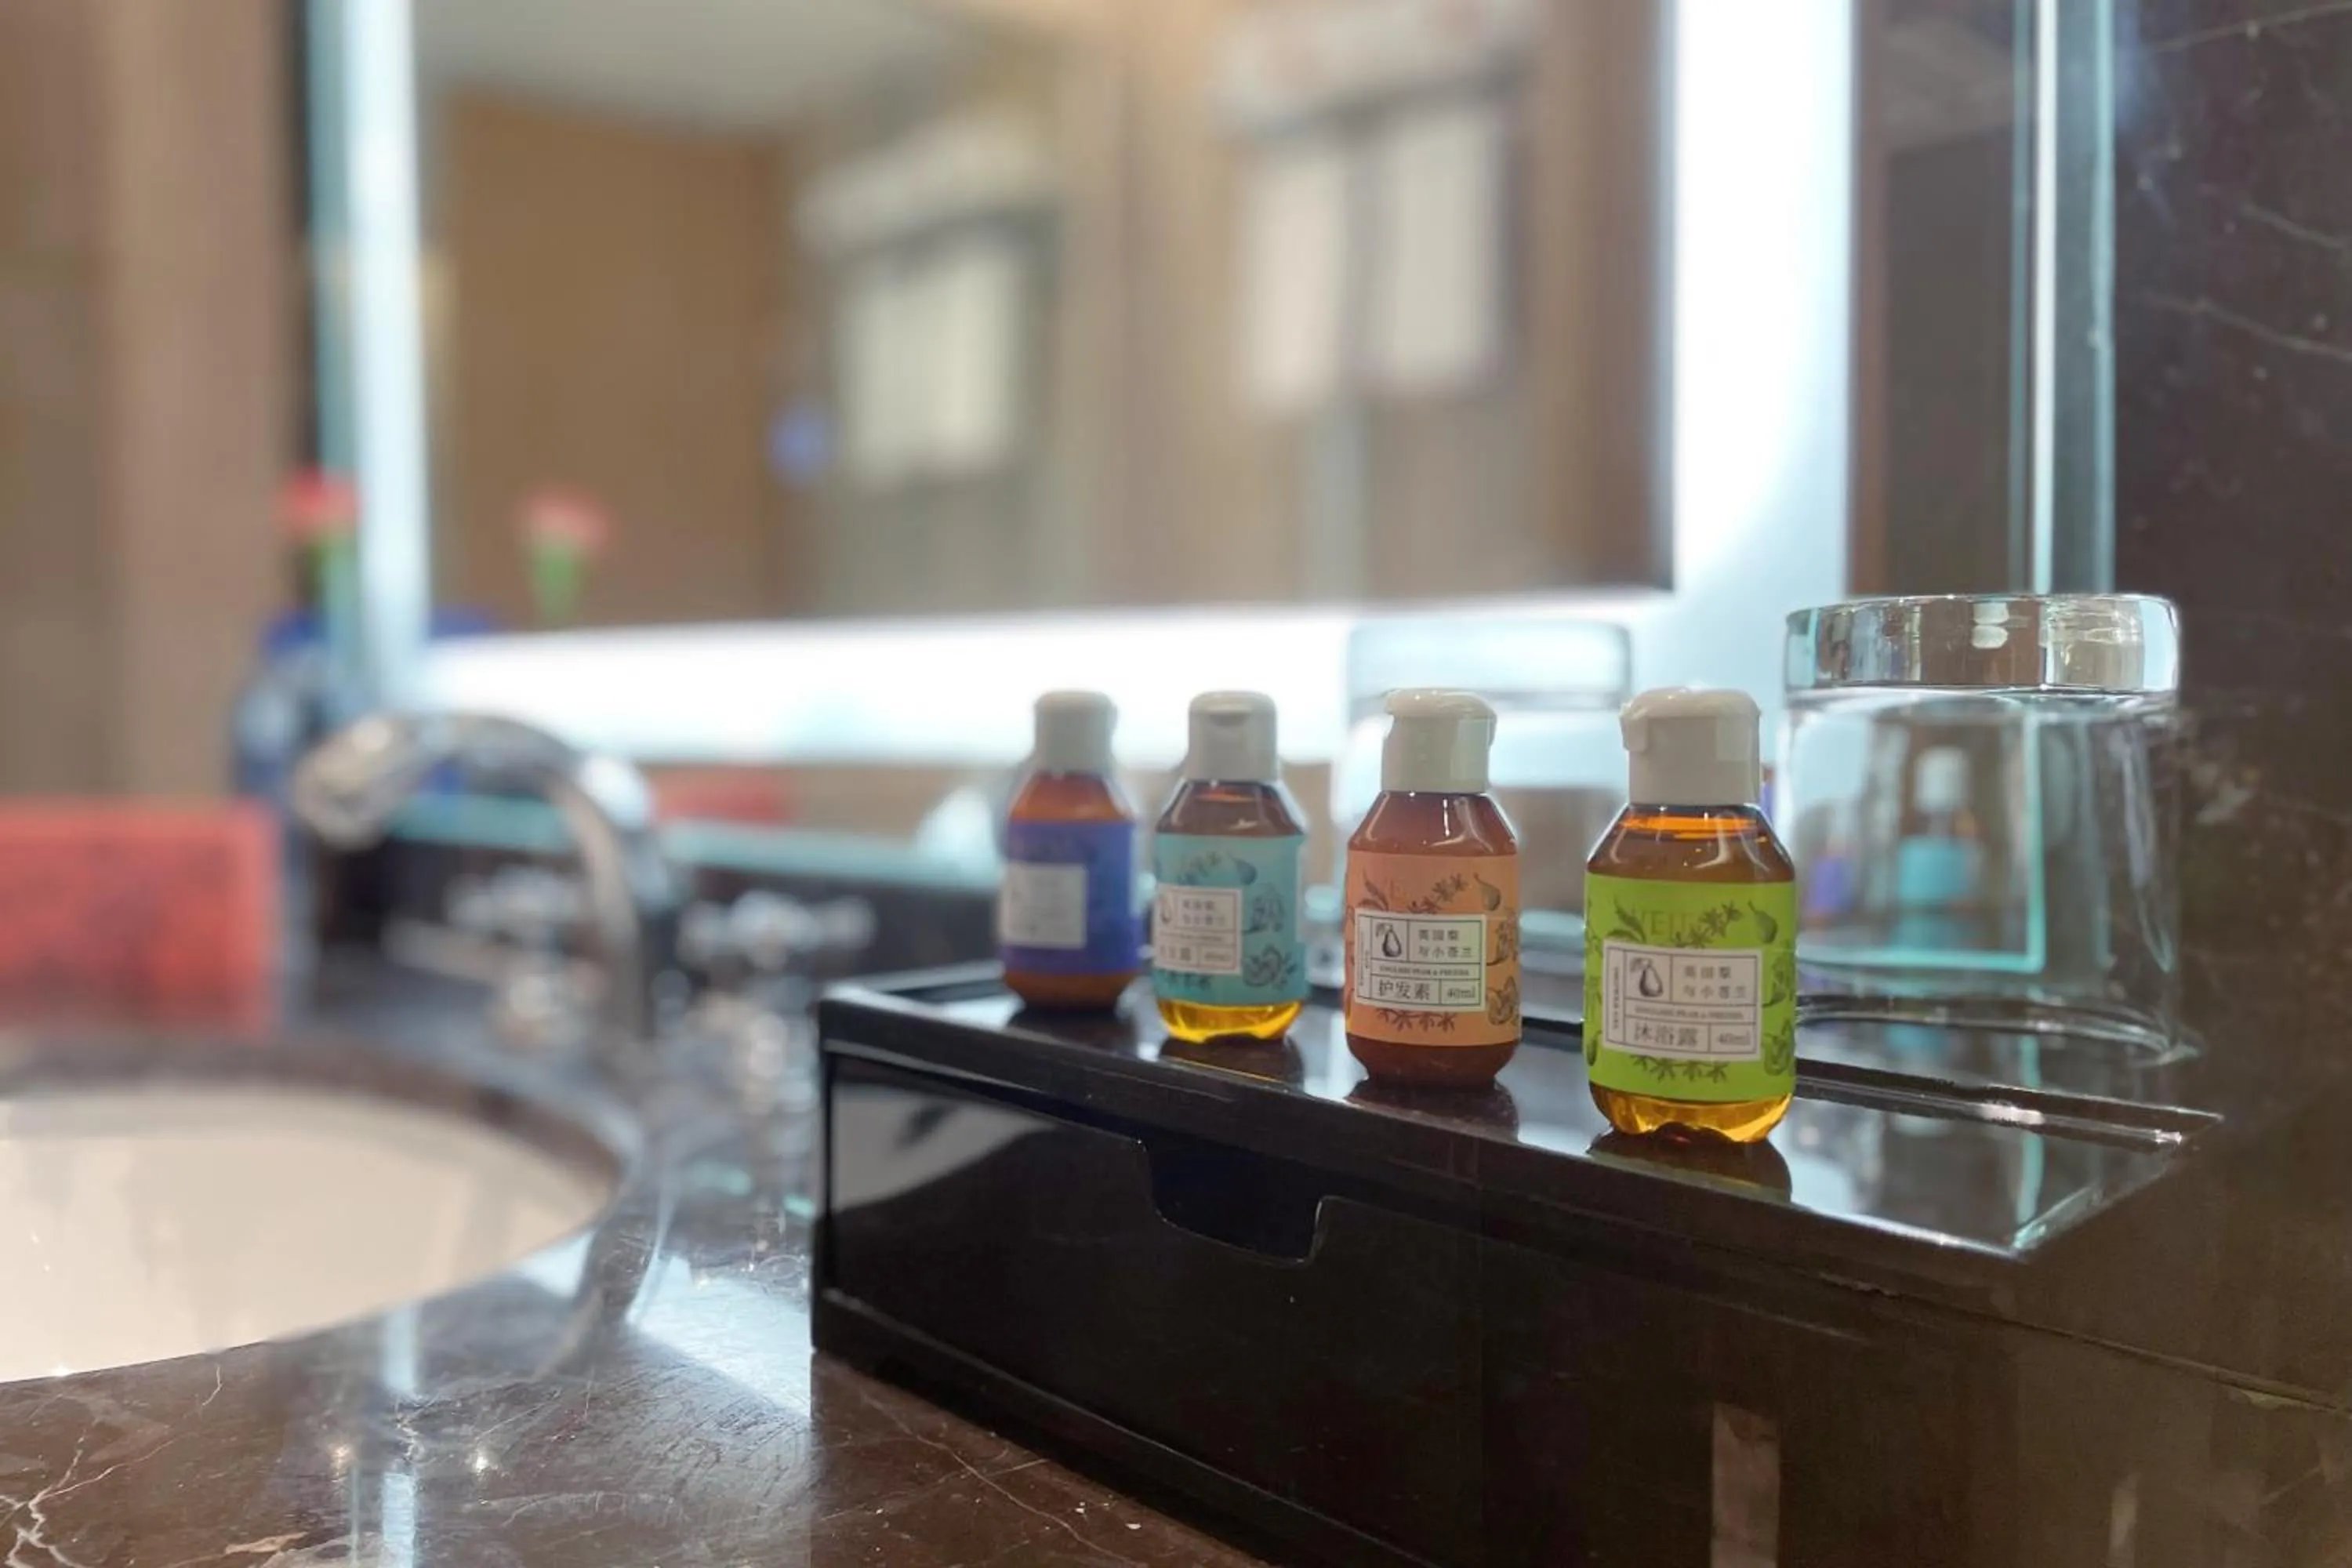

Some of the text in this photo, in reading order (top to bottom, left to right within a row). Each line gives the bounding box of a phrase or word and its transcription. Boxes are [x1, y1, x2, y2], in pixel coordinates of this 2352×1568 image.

[1379, 979, 1430, 1000] 护发素
[1447, 985, 1475, 999] 40ml
[1634, 1021, 1698, 1047] 沐浴露
[1719, 1030, 1751, 1045] 40ml
